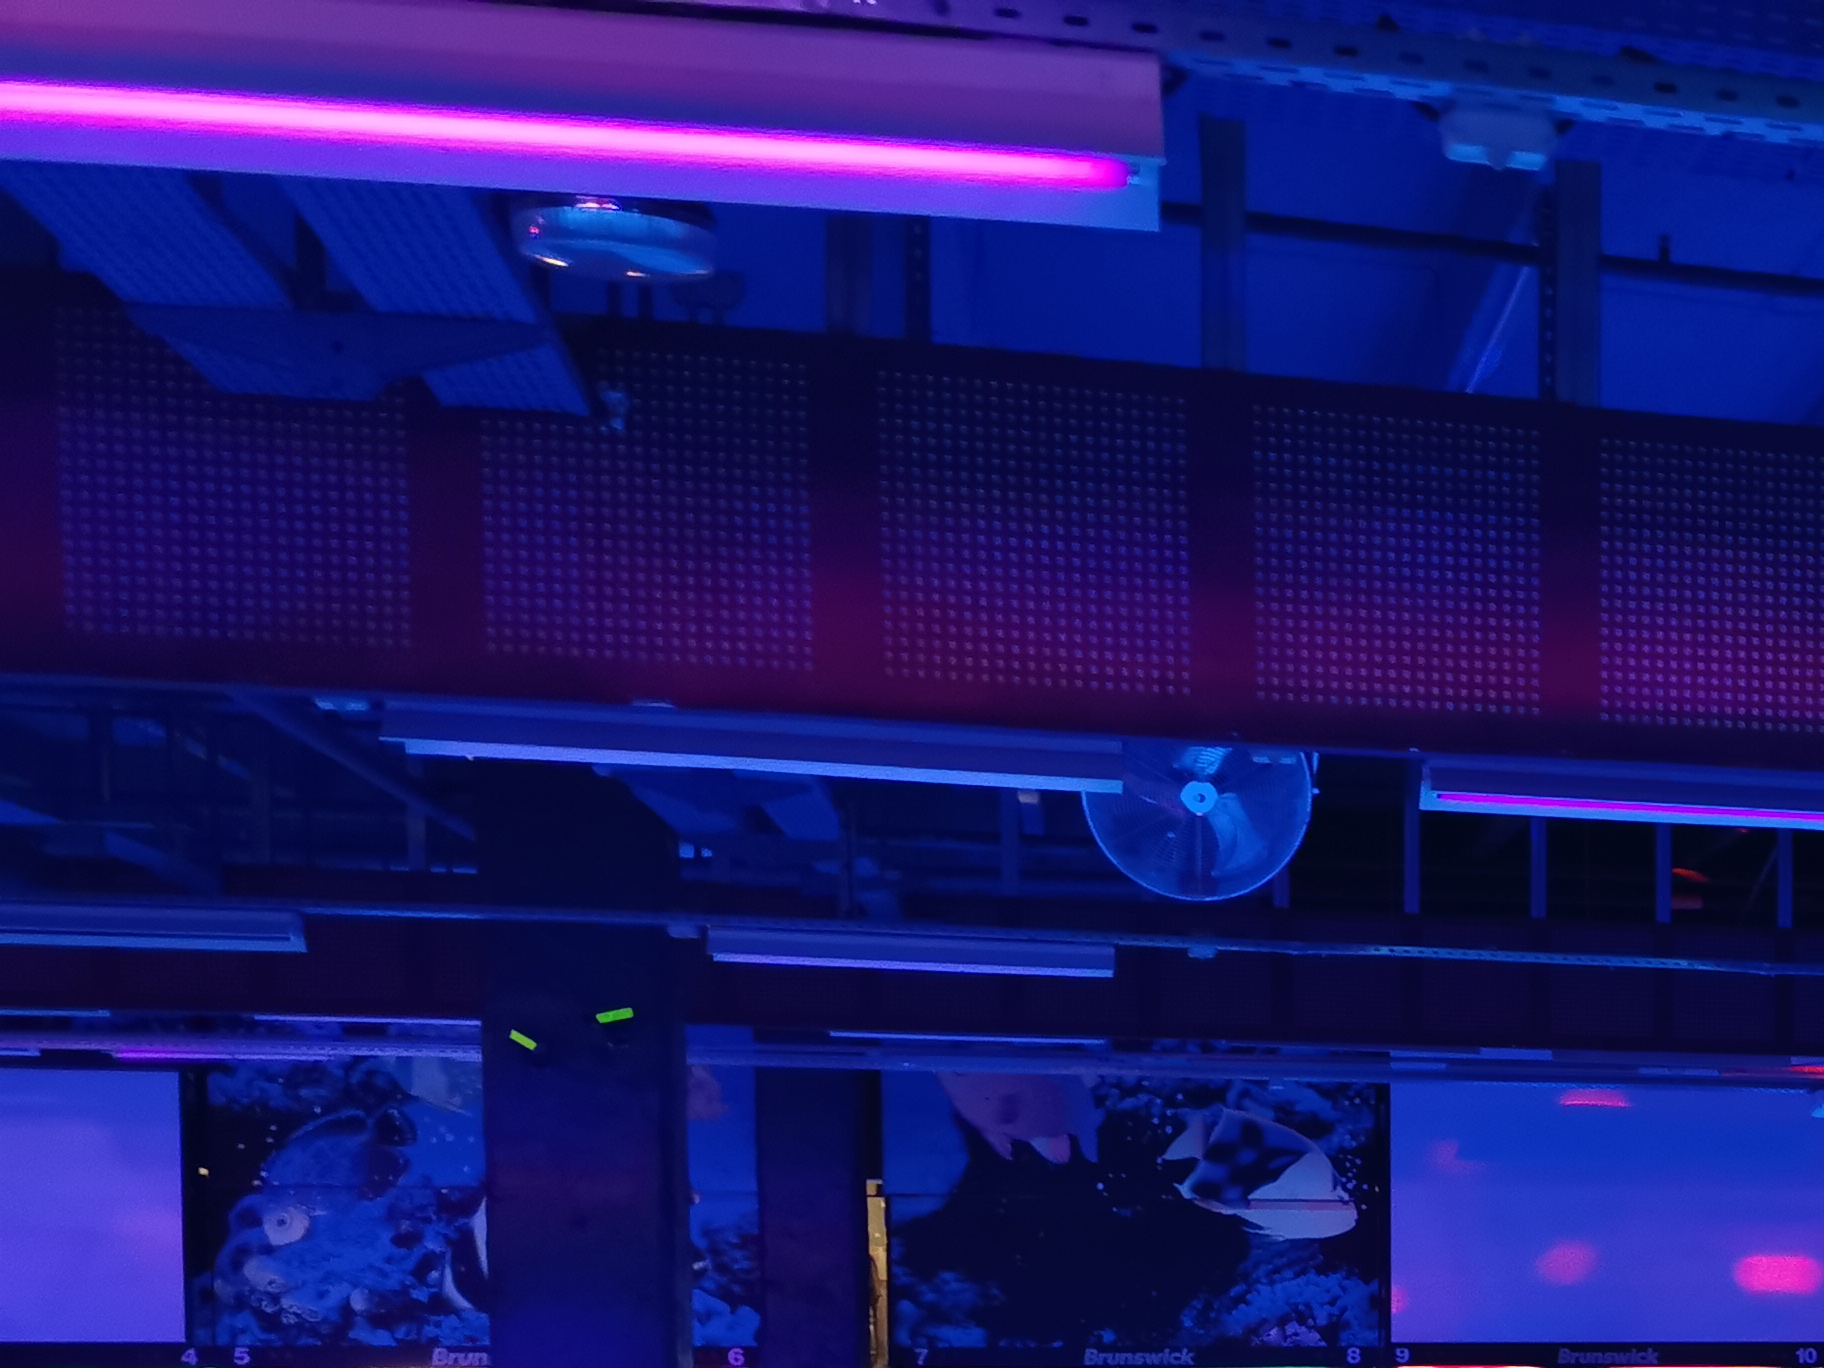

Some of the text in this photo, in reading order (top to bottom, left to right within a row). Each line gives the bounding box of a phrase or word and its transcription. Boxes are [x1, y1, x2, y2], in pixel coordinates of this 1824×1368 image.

[181, 1347, 198, 1366] 4
[233, 1347, 251, 1366] 5
[432, 1348, 490, 1367] Brun
[728, 1347, 745, 1366] 6
[915, 1347, 929, 1365] 7
[1084, 1348, 1195, 1366] Brunswick
[1345, 1347, 1362, 1364] 8
[1395, 1347, 1410, 1364] 9
[1557, 1348, 1659, 1365] Brunswick
[1795, 1347, 1818, 1364] 10
